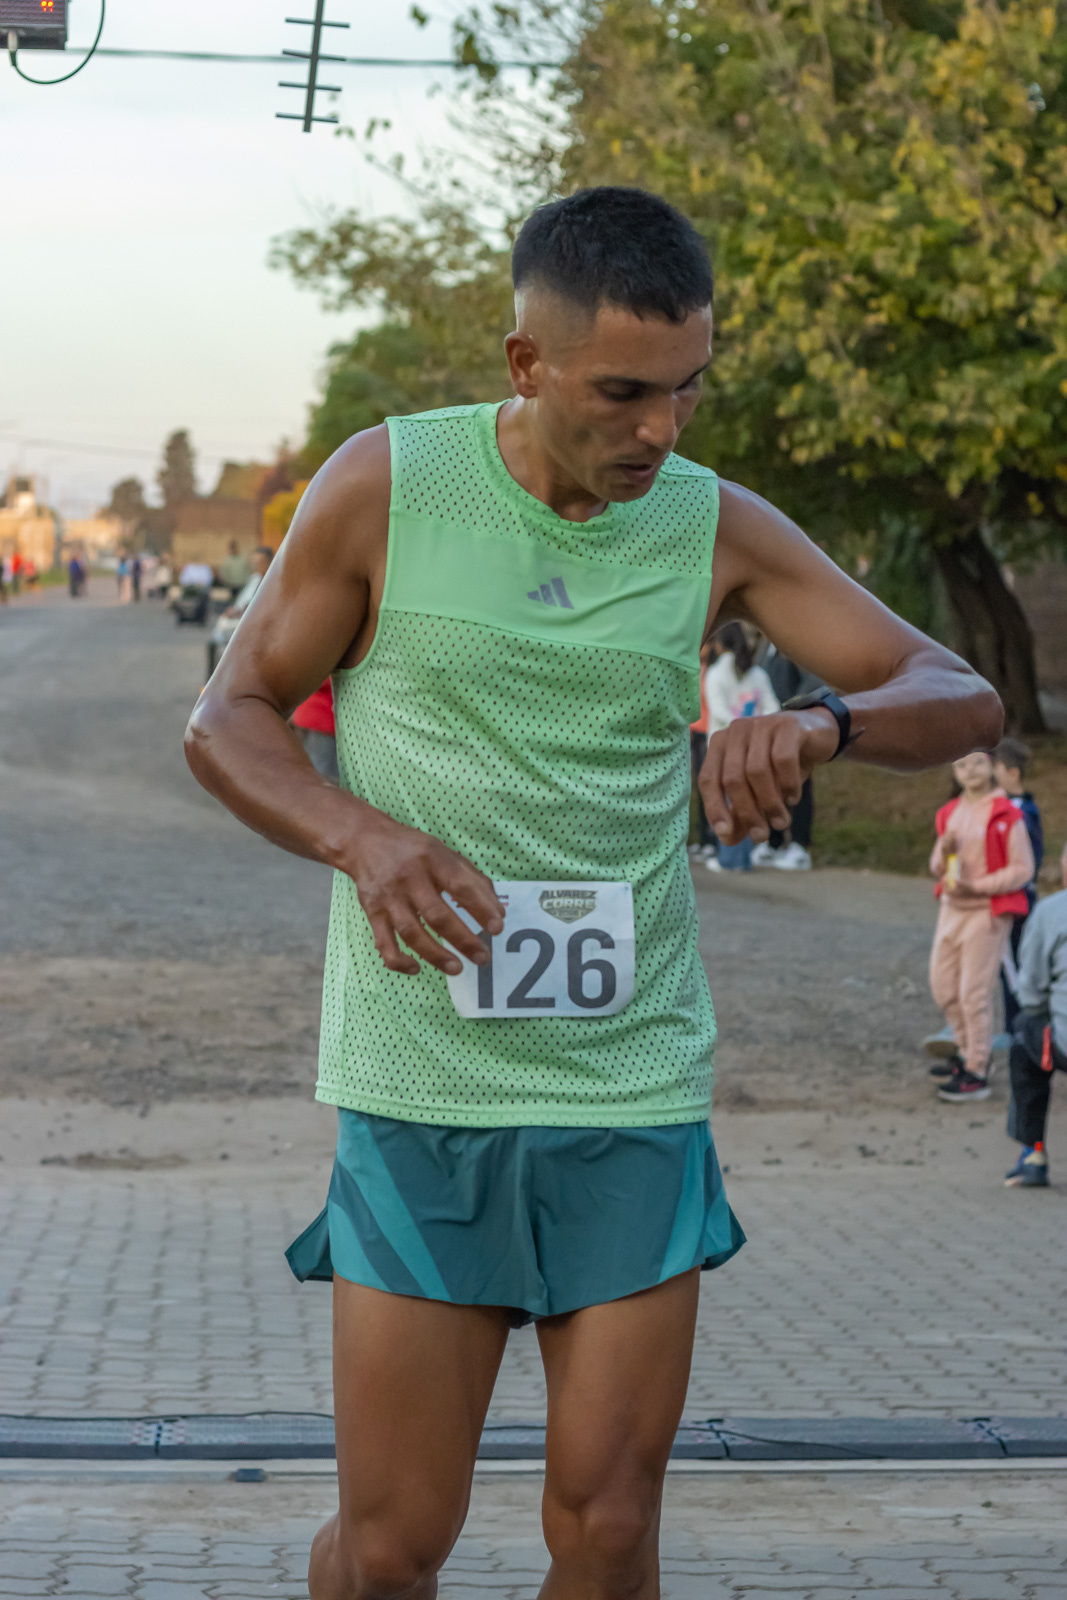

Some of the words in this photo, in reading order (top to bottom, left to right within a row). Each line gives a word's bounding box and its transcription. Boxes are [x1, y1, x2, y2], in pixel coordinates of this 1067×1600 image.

[541, 890, 597, 899] ALVAREZ
[542, 899, 595, 909] CORRE
[477, 928, 616, 1009] 126
